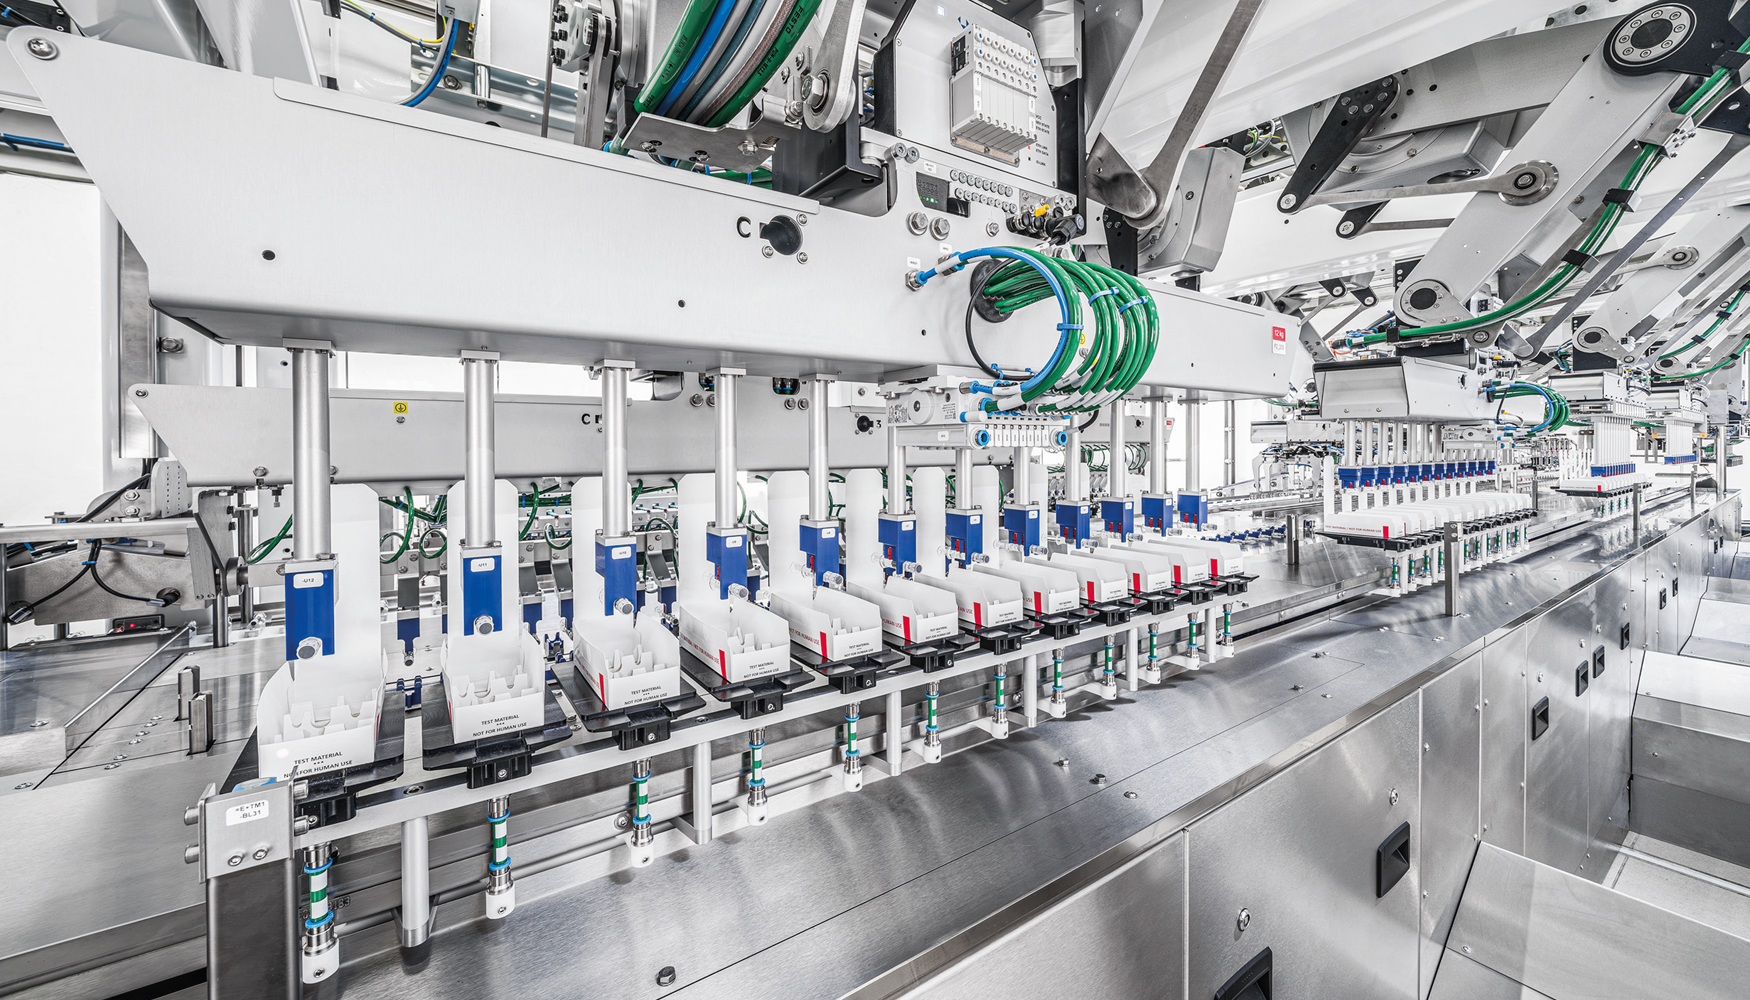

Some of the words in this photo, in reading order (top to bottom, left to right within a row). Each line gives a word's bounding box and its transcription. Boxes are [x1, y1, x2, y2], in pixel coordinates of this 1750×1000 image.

[785, 5, 804, 34] FESTO
[737, 216, 751, 238] C
[1274, 329, 1279, 337] 12
[581, 413, 591, 425] C
[876, 419, 882, 429] 3
[494, 714, 519, 723] MATERIAL
[294, 756, 309, 765] TEST
[310, 751, 343, 762] MATERIAL
[314, 762, 340, 772] HUMAN
[235, 801, 266, 812] =E+TM1
[240, 810, 262, 819] -BL31
